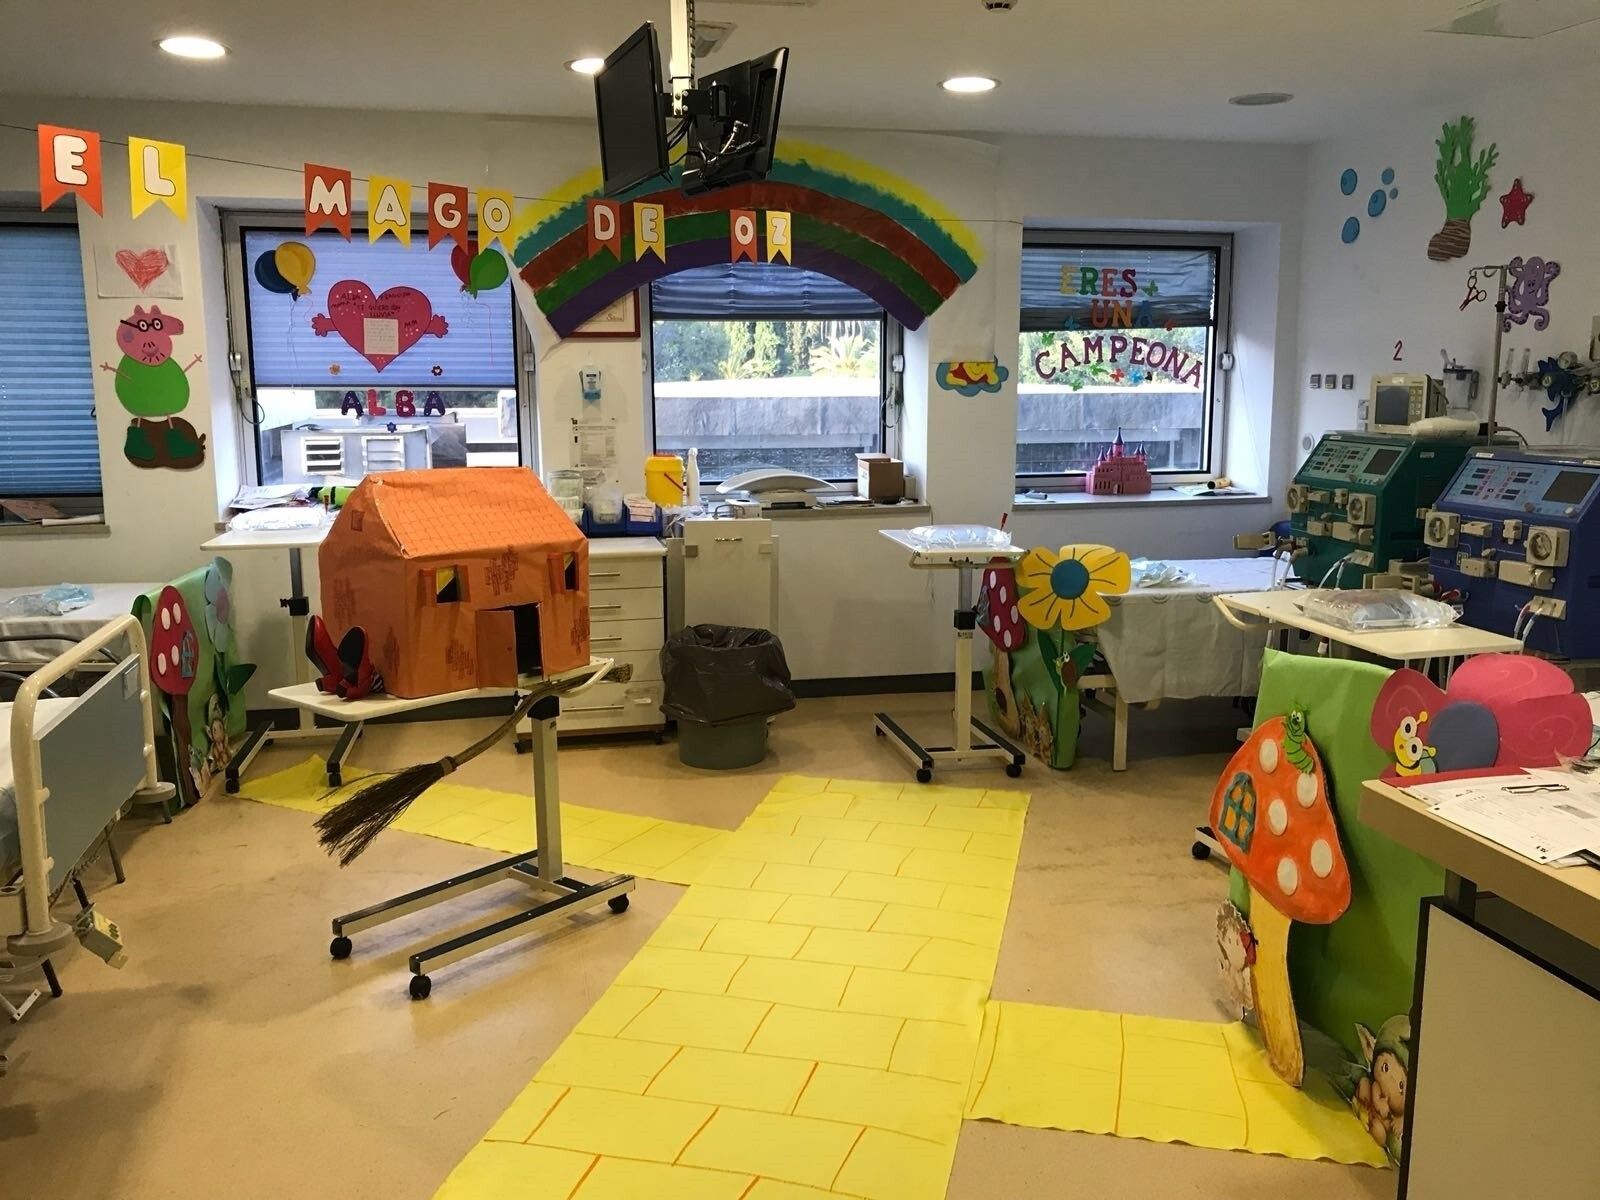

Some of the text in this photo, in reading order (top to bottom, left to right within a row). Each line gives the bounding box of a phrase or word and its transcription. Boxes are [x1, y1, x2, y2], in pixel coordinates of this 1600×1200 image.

[53, 134, 788, 245] EL MAGO DE OZ
[1059, 265, 1138, 298] ERES
[1090, 298, 1151, 329] UNA
[1035, 336, 1203, 389] CAMPEONA
[1393, 340, 1403, 361] 2
[341, 389, 446, 417] ALBA
